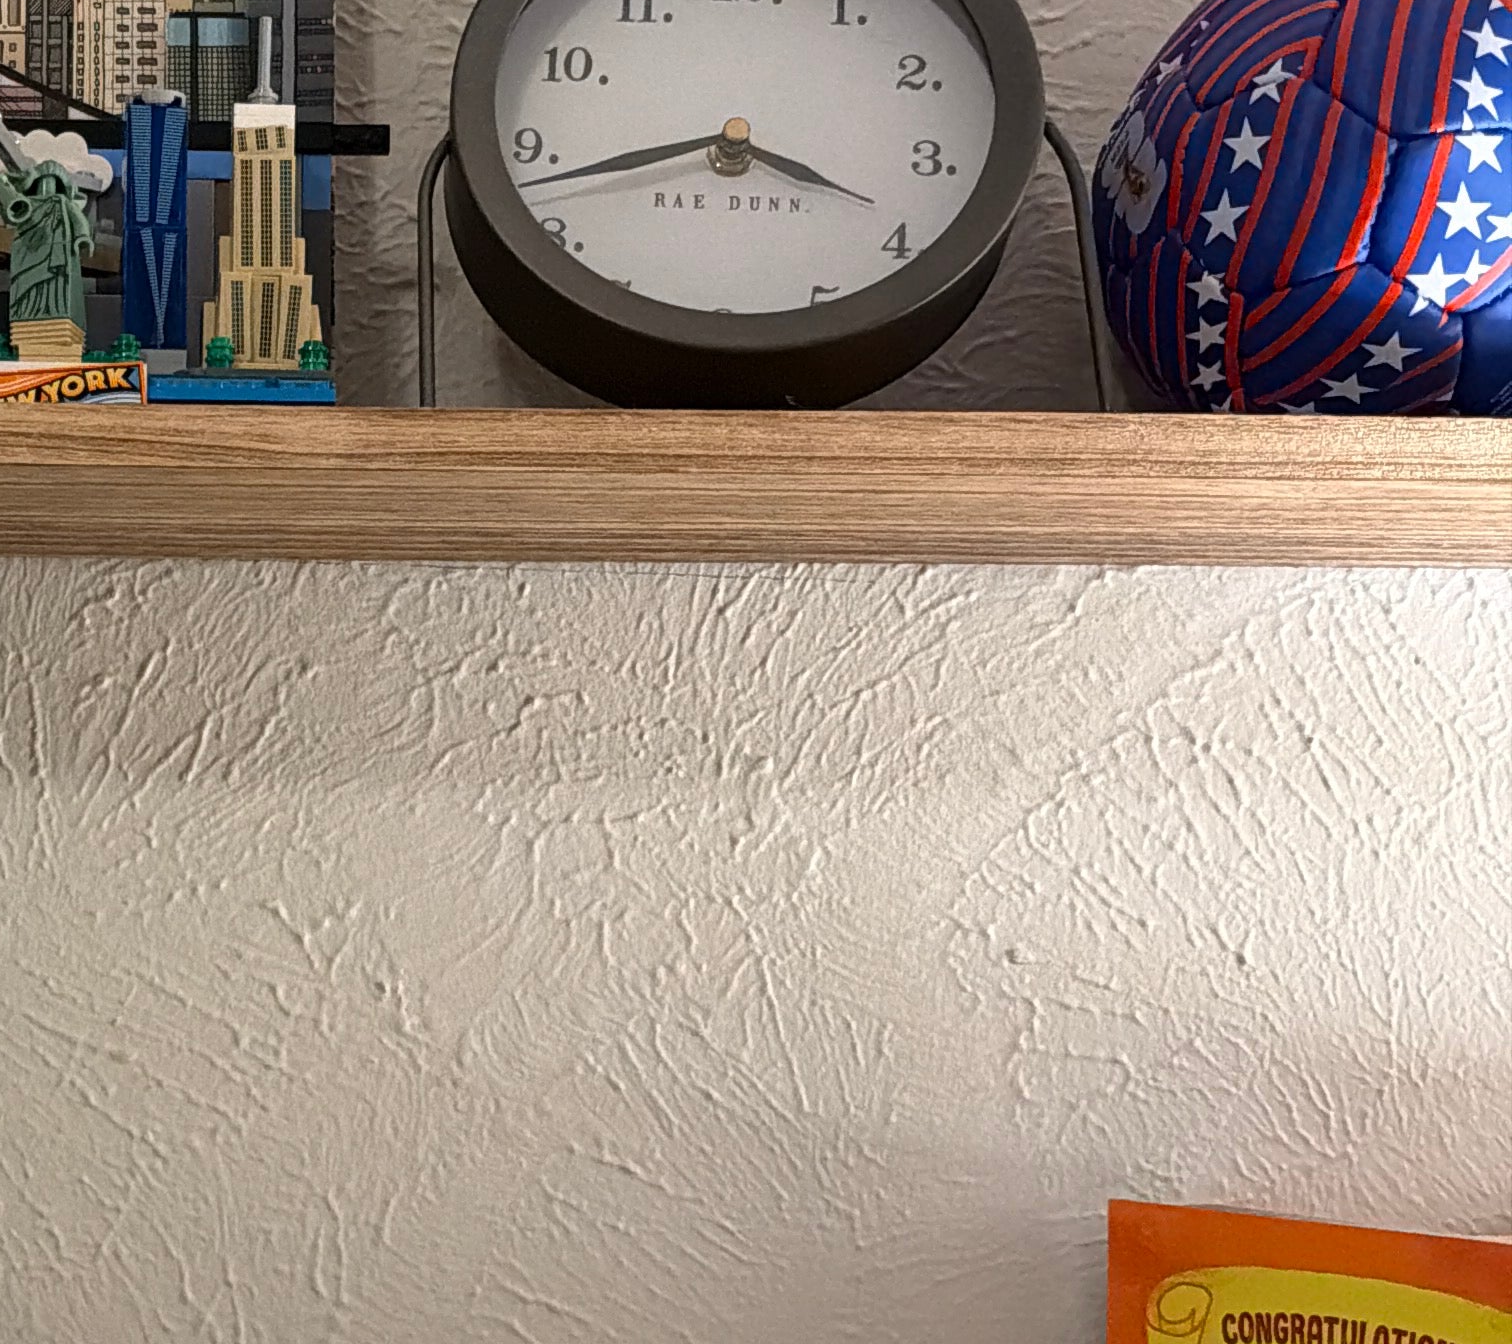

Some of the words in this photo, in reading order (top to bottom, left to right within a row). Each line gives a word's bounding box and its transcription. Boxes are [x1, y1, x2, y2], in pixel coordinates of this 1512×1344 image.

[541, 46, 609, 86] 10.
[896, 54, 942, 92] 2.
[512, 127, 559, 165] 9.
[911, 139, 957, 177] 3.
[654, 192, 706, 211] RAE
[41, 367, 133, 403] YORK
